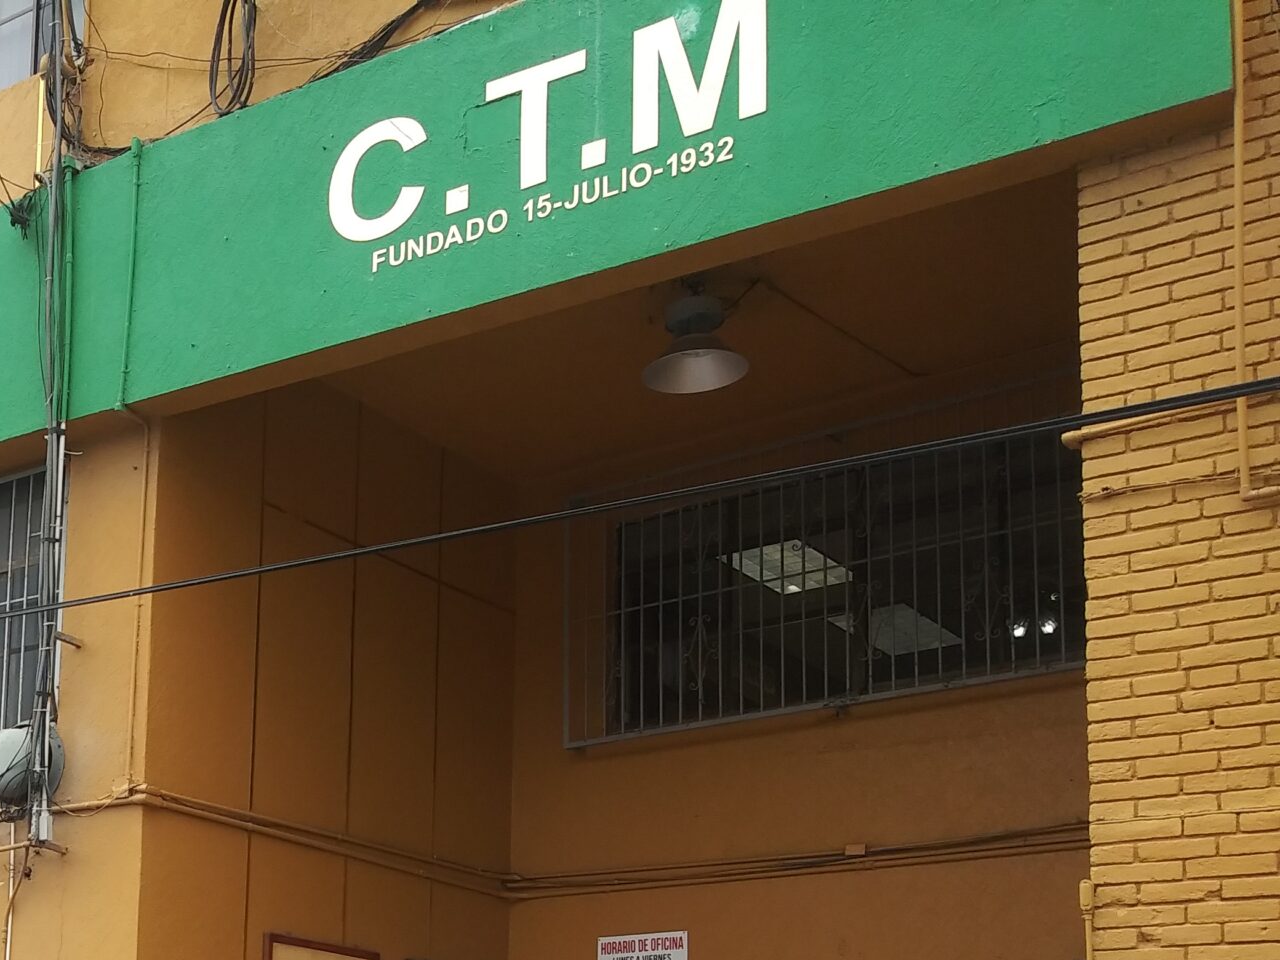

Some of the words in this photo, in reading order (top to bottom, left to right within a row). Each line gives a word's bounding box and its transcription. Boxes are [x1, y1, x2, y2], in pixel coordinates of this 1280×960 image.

[371, 208, 508, 273] FUNDADO
[522, 135, 735, 223] 15-JULIO-1932
[601, 940, 636, 955] HORARIO
[638, 939, 648, 952] DE
[651, 936, 684, 951] OFICINA
